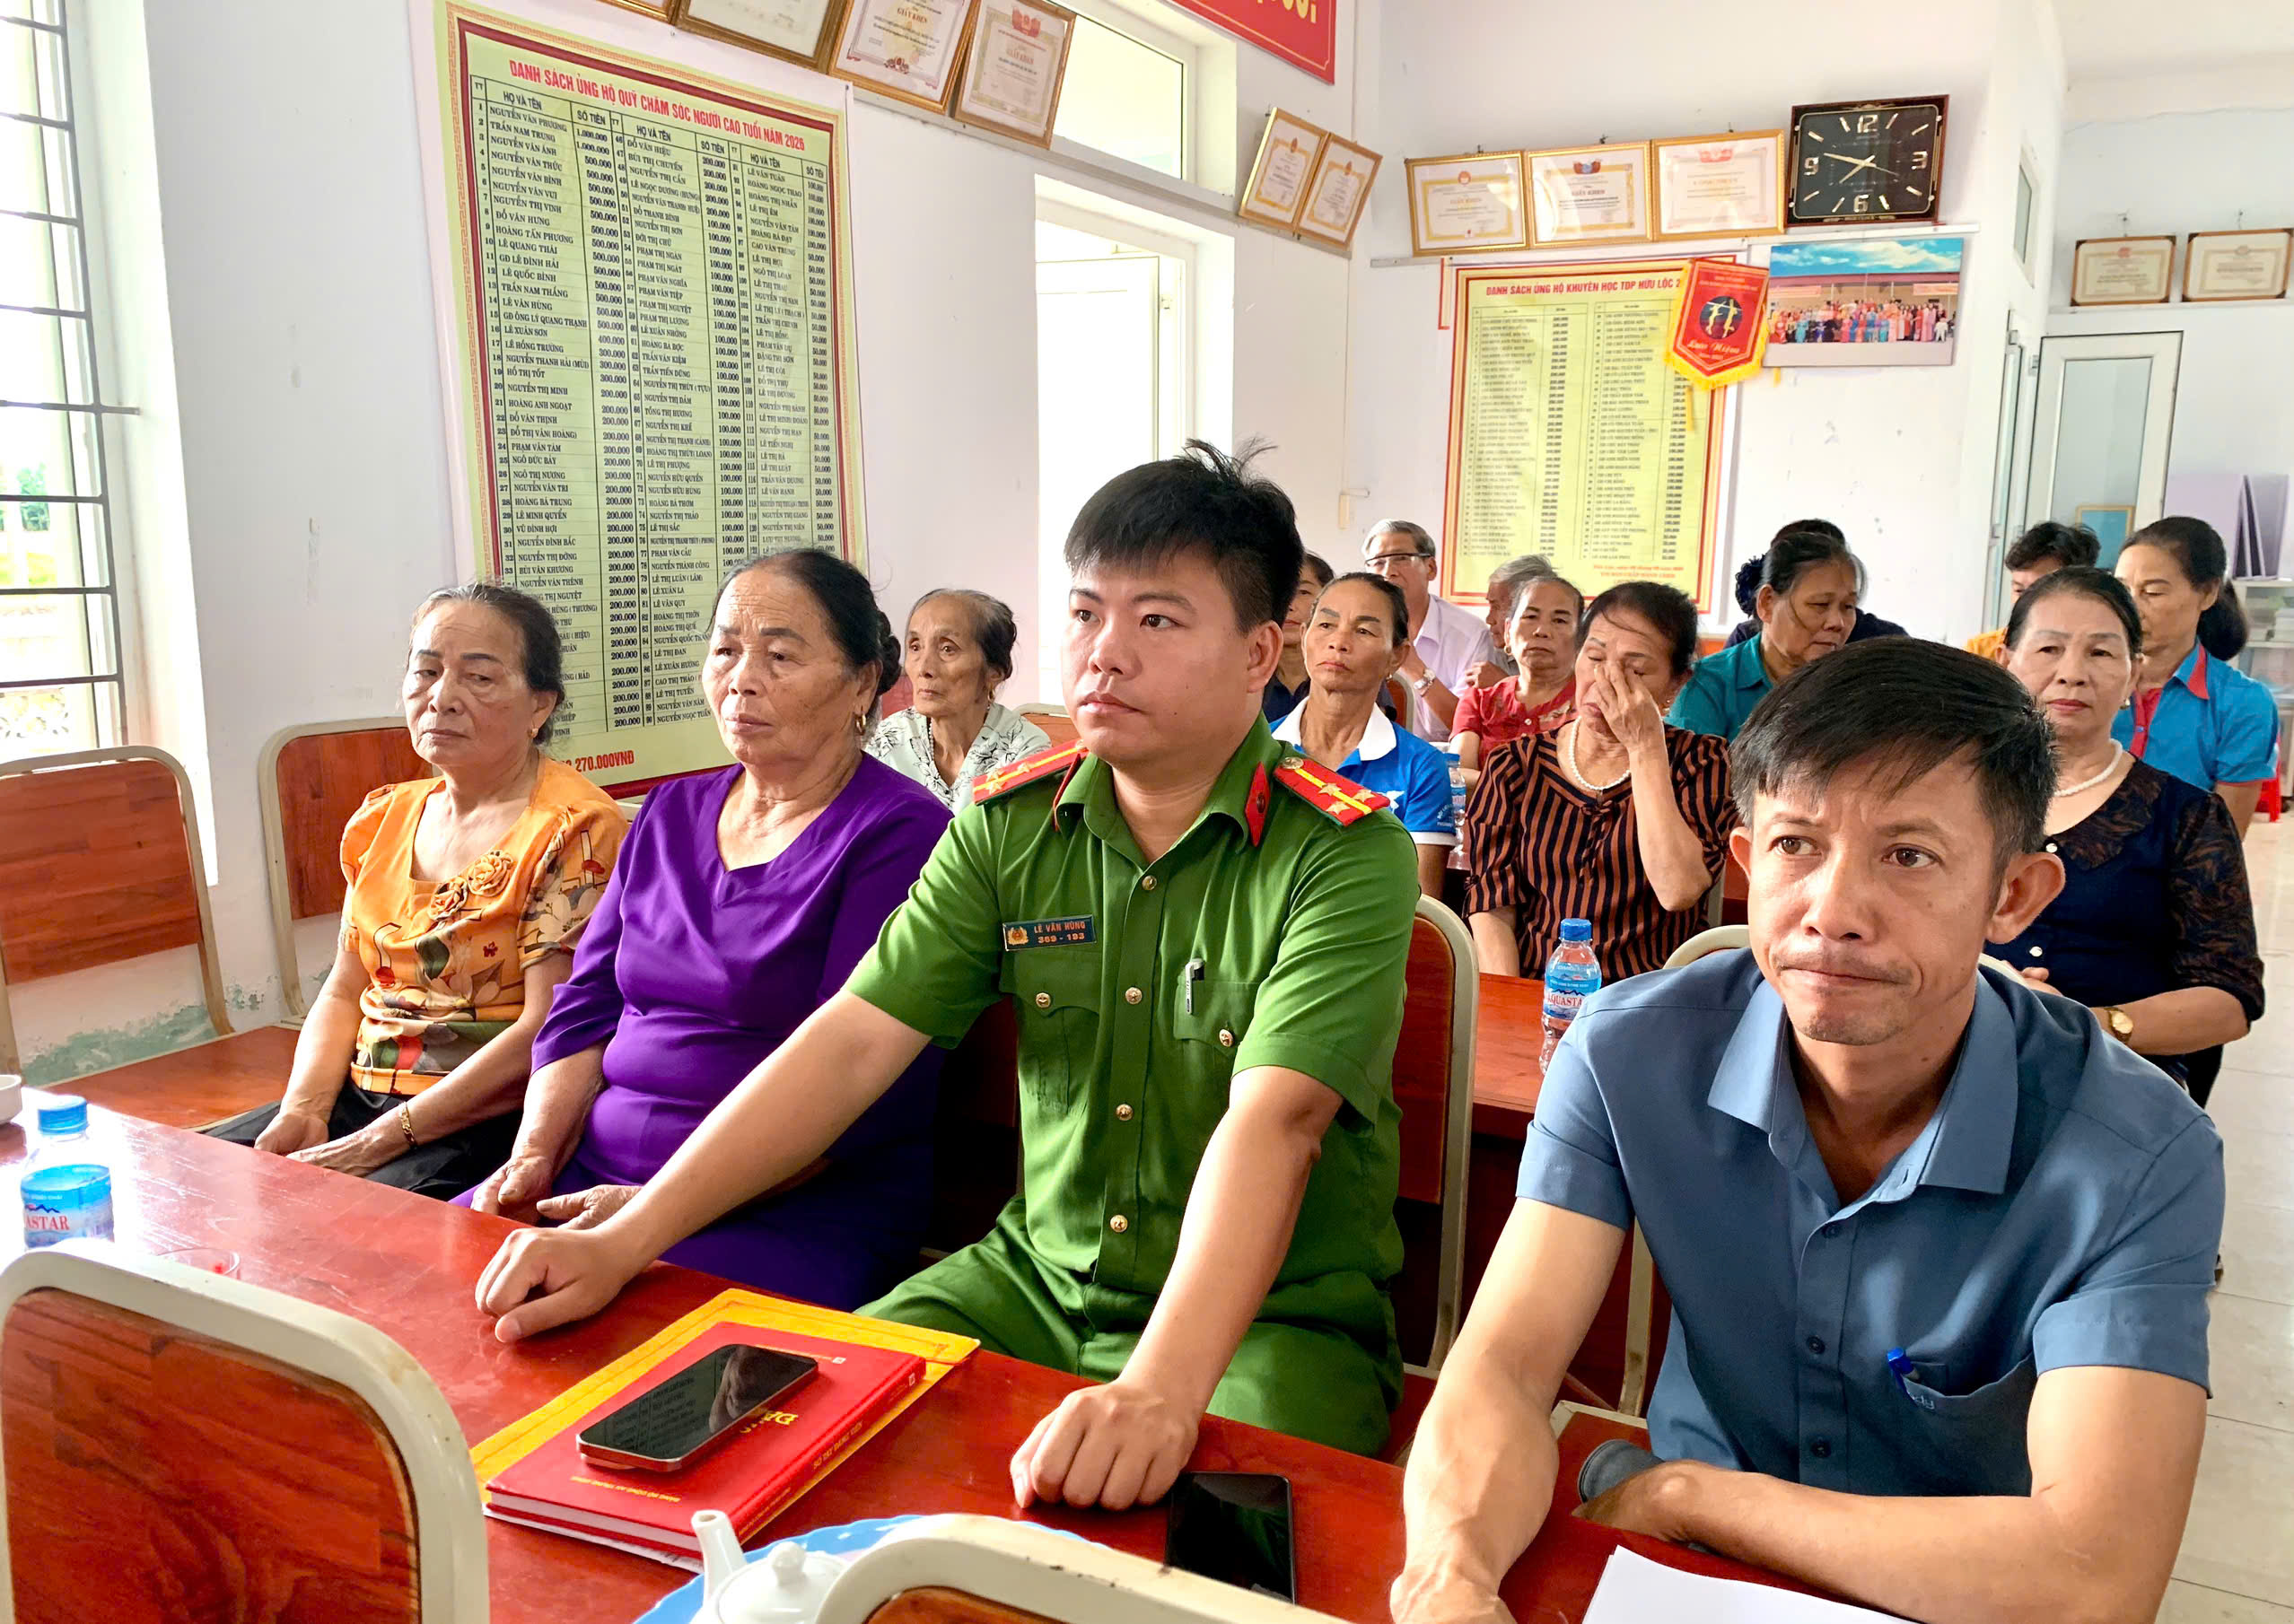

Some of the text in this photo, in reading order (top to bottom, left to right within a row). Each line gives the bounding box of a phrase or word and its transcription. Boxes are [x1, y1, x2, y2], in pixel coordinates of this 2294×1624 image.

[503, 92, 542, 110] HỌ VÀ TÊN
[510, 60, 541, 83] DANH
[544, 68, 573, 91] SÁCH
[577, 74, 599, 98] ỦNG
[601, 83, 615, 105] HỘ
[641, 95, 669, 116] CHĂM
[672, 102, 690, 121] SÓC
[723, 118, 740, 135] CAO
[743, 119, 761, 139] TUỔI
[764, 127, 784, 145] NĂM
[1858, 115, 1878, 133] 12
[513, 126, 530, 137] NAM
[637, 126, 646, 136] HỌ
[658, 128, 671, 142] TÊN
[770, 157, 781, 168] TÊN
[1804, 157, 1819, 175] 9
[1912, 151, 1928, 170] 3
[586, 170, 614, 183] 500.000
[588, 183, 615, 196] 500.000
[1854, 195, 1869, 213] 6
[591, 210, 617, 223] 500.000
[510, 240, 537, 253] QUANG
[593, 266, 621, 278] 500.000
[524, 285, 540, 295] NAM
[596, 293, 622, 305] 500.000
[712, 284, 734, 295] 100.000
[713, 297, 736, 308] 100.000
[540, 316, 564, 326] QUANG
[598, 320, 624, 331] 500.000
[599, 336, 625, 345] 400.000
[600, 374, 626, 384] 300.000
[551, 387, 568, 396] MINH
[601, 389, 627, 398] 200.000
[602, 405, 628, 415] 200.000
[603, 432, 629, 441] 200.000
[603, 446, 630, 454] 200.000
[605, 485, 632, 493] 200.000
[607, 524, 634, 532] 200.000
[609, 563, 635, 572] 200.000
[609, 575, 635, 583] 200.000
[611, 639, 637, 647] 200.000
[612, 679, 639, 688] 200.000
